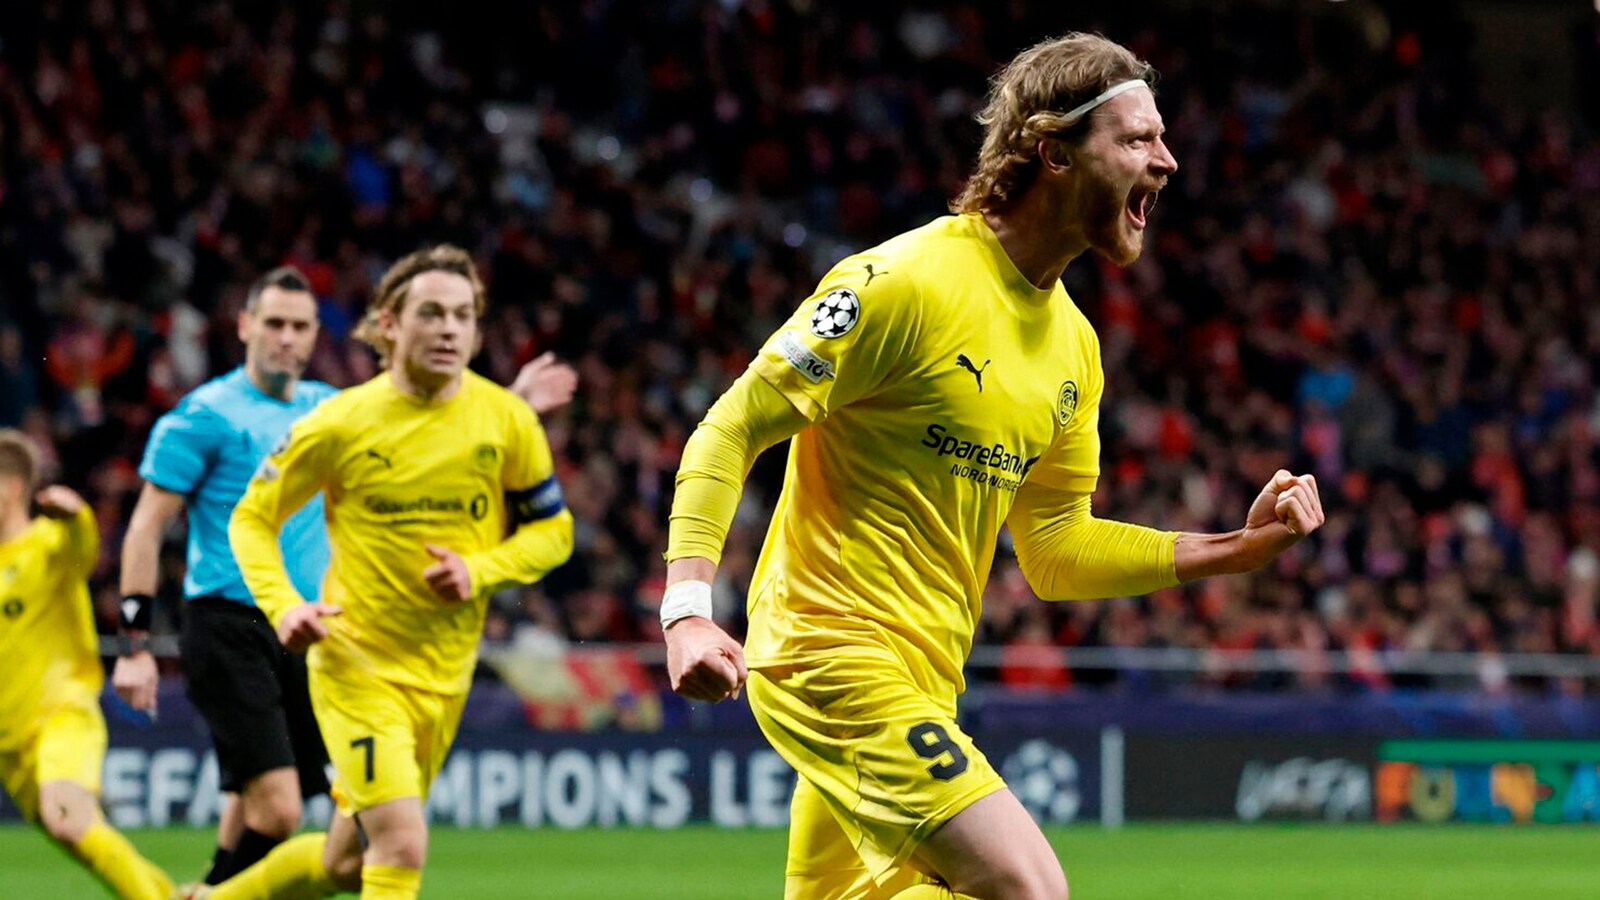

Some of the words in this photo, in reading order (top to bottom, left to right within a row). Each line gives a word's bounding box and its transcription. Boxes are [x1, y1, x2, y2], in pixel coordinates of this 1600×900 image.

[906, 722, 968, 780] 9
[102, 749, 231, 827] EFA
[426, 748, 692, 828] MPIONS
[710, 748, 794, 828] LE
